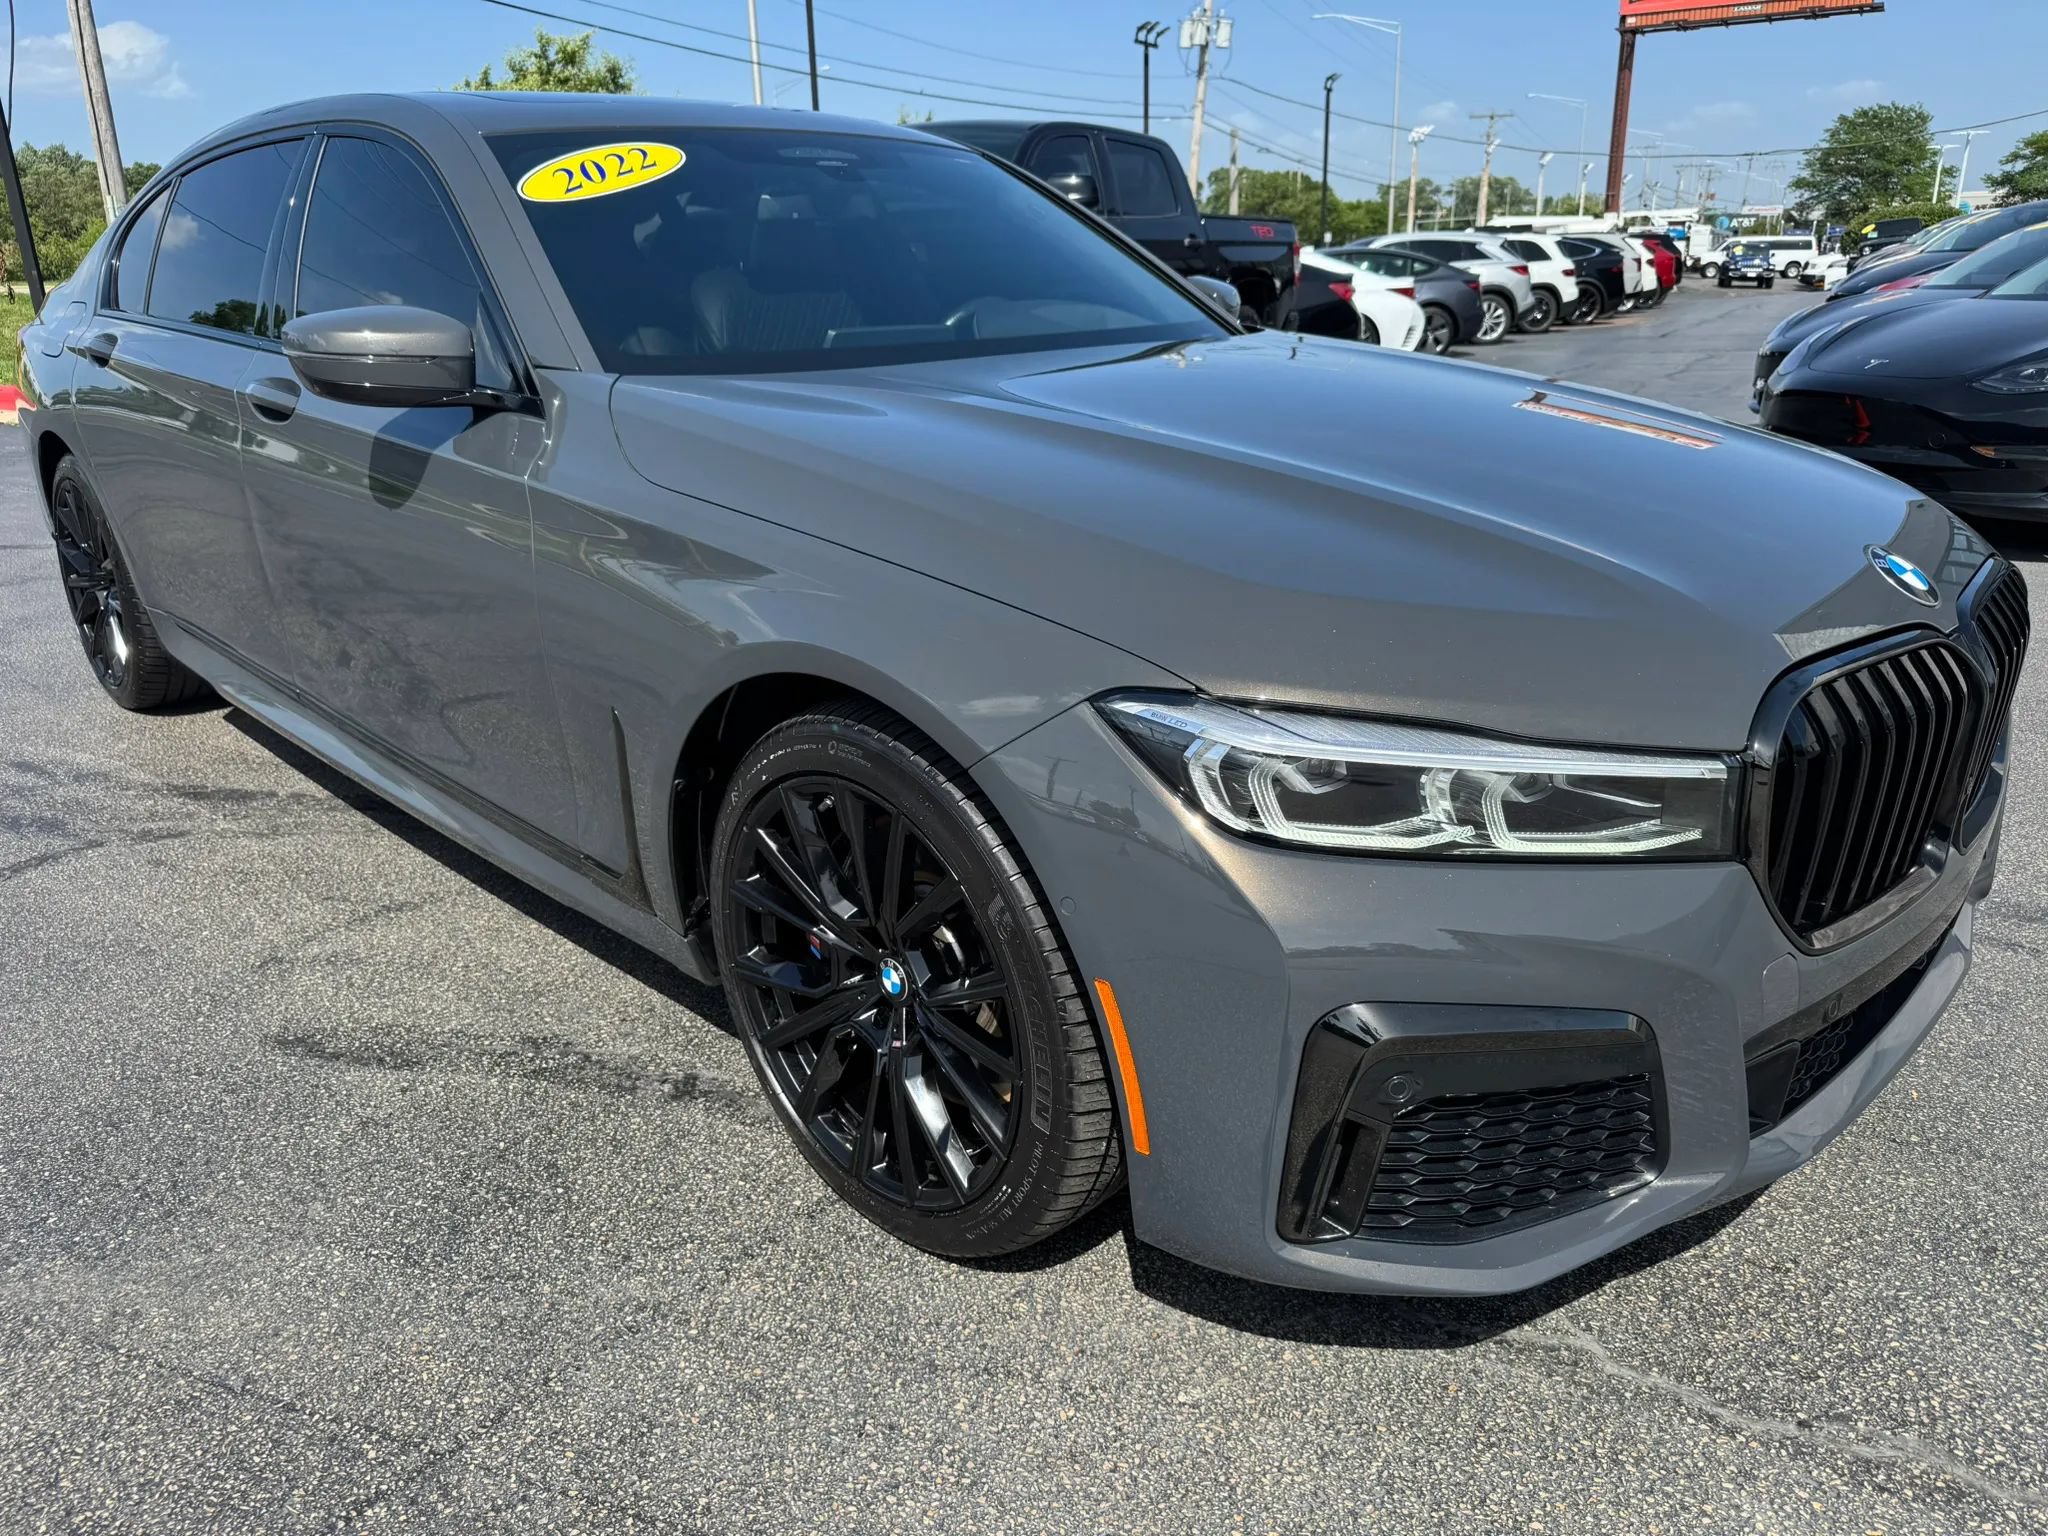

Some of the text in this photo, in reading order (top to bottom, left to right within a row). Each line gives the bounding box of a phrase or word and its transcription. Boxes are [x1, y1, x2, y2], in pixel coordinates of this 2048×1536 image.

[552, 147, 657, 195] 2022
[1729, 216, 1758, 228] AT&T
[1169, 718, 1188, 728] LED
[880, 959, 904, 979] BMW
[1028, 1140, 1044, 1176] PILOT
[1012, 1174, 1033, 1208] SPORT
